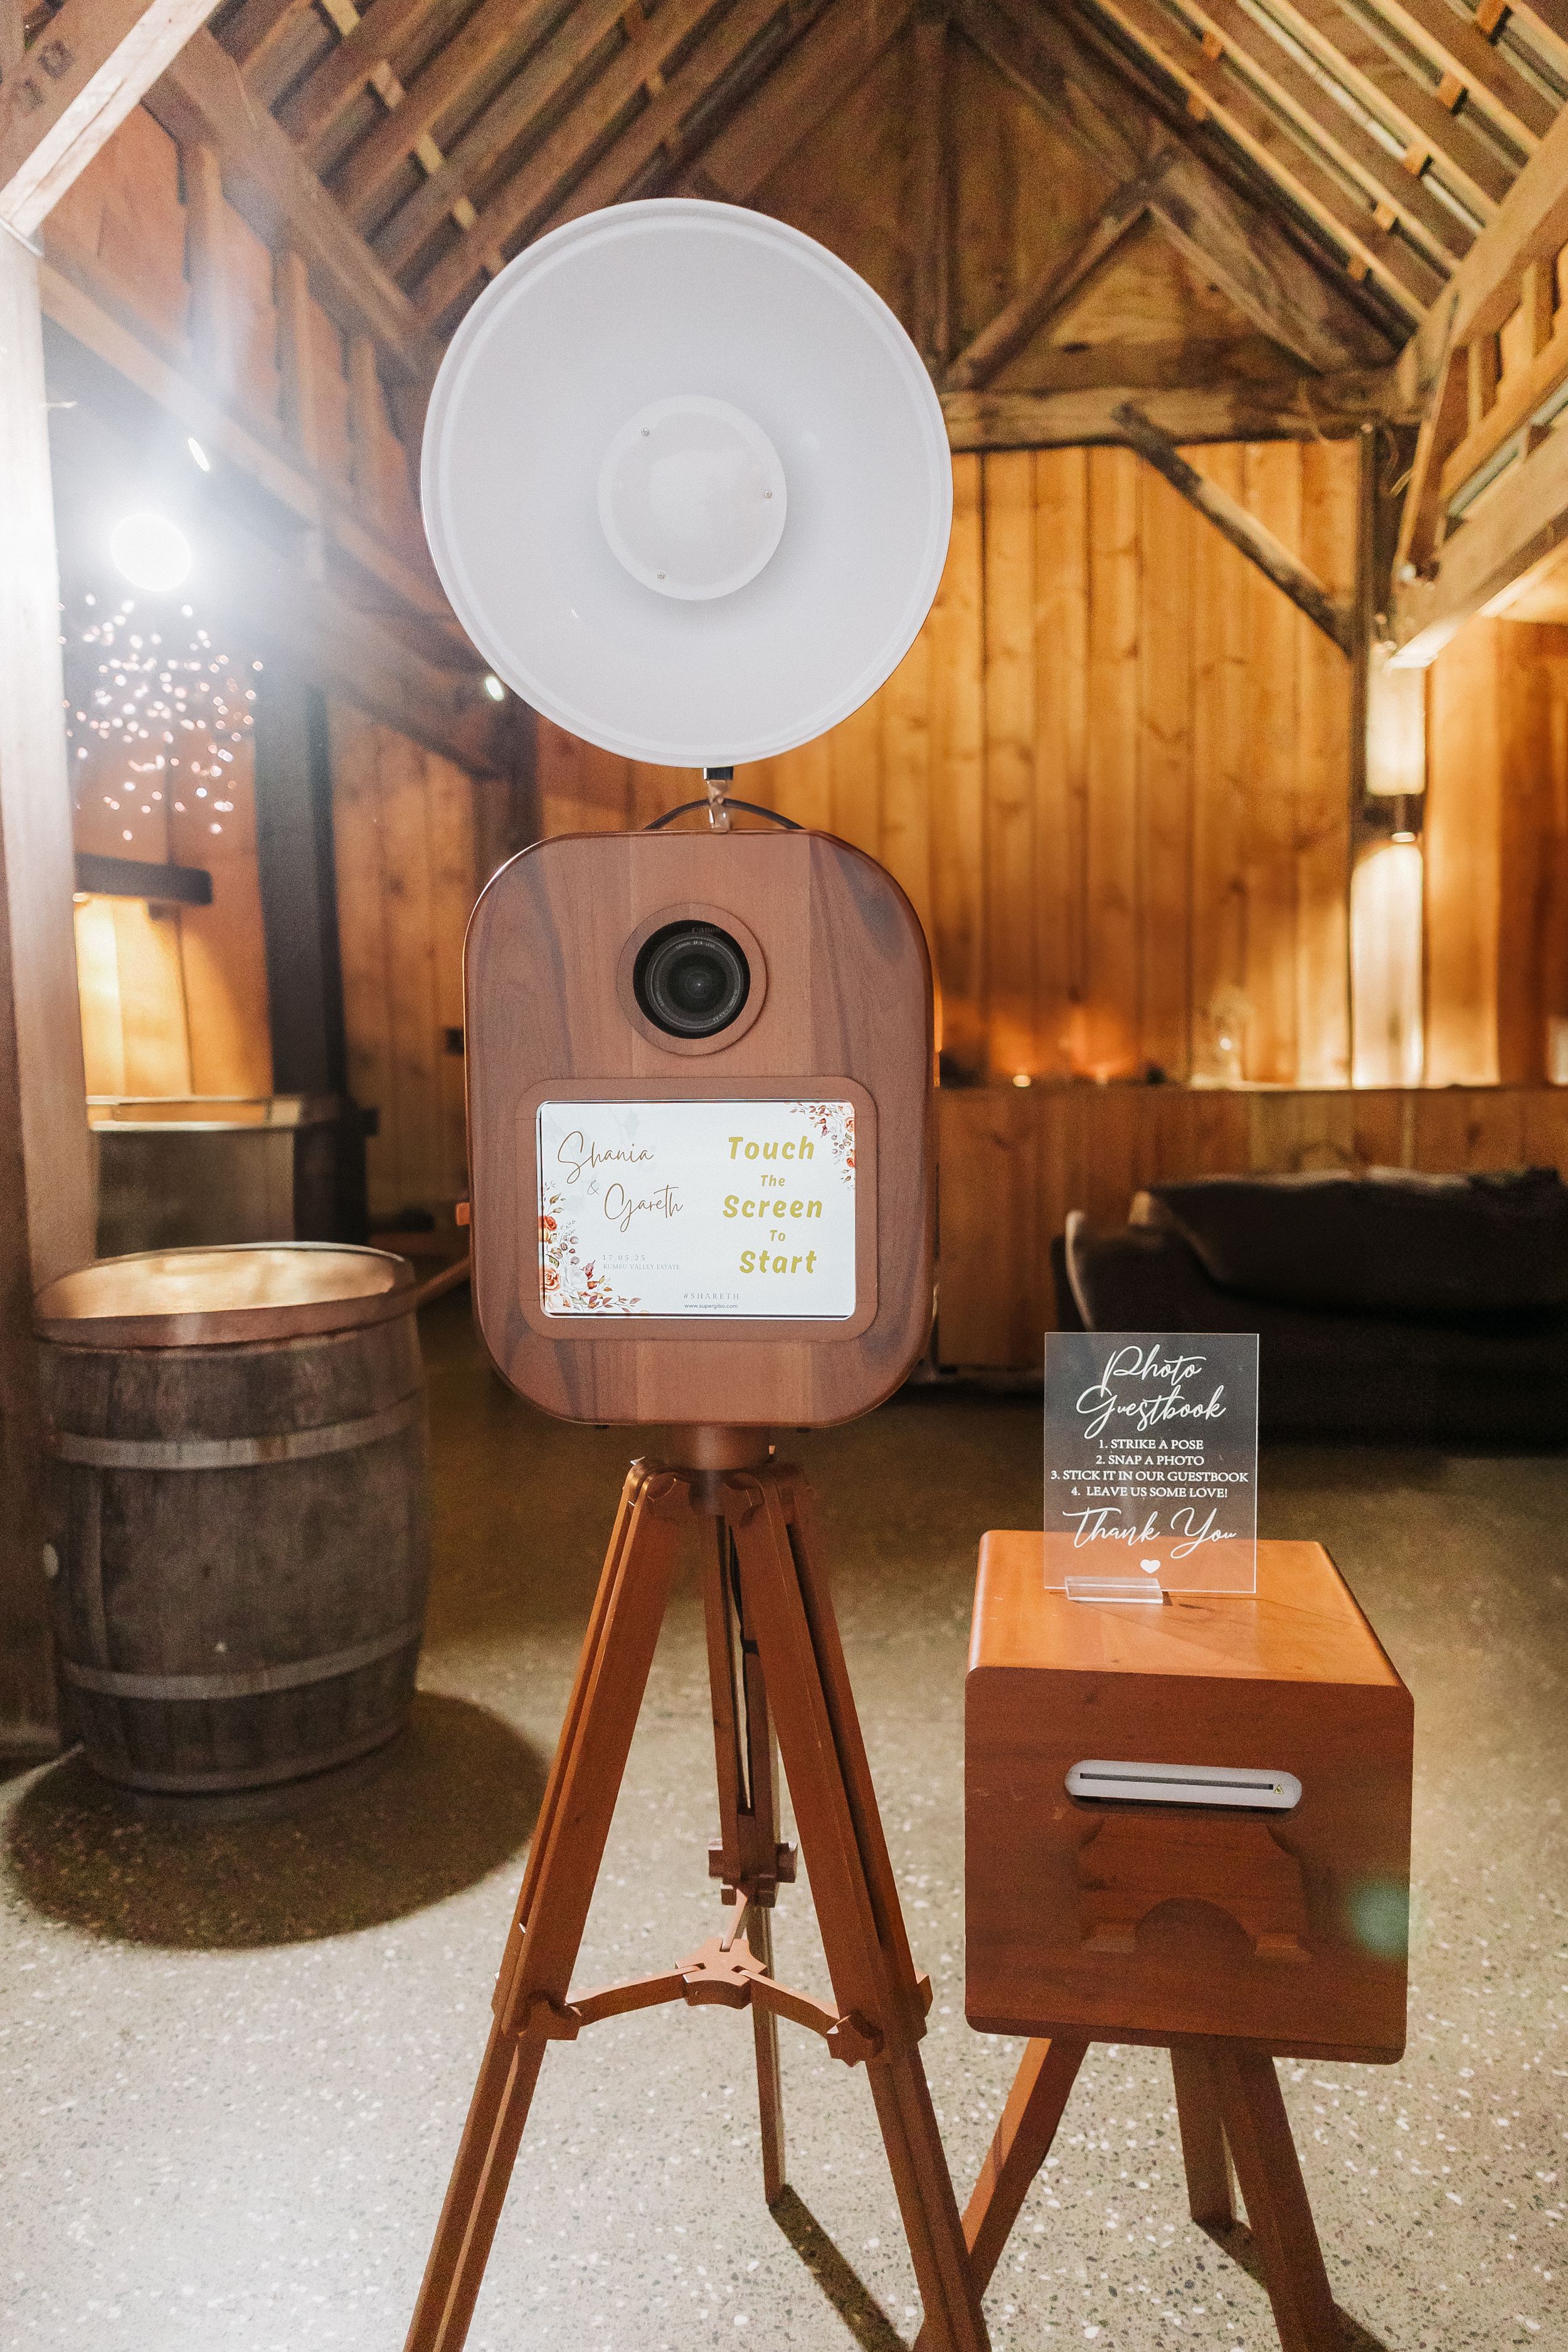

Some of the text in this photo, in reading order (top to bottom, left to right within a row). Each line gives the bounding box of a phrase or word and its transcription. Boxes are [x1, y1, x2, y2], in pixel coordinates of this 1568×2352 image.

[557, 1131, 654, 1184] Shania
[728, 1136, 815, 1160] Touch
[586, 1179, 600, 1195] &
[760, 1175, 786, 1187] The
[604, 1183, 684, 1232] Gareth
[723, 1194, 823, 1219] Screen
[770, 1229, 787, 1242] To
[739, 1250, 817, 1274] Start
[683, 1292, 739, 1300] #SHARETH
[1100, 1344, 1207, 1397] Photo
[1076, 1384, 1226, 1439] Guestbook
[1099, 1439, 1204, 1450] 1. STRIKE A POSE
[1096, 1455, 1205, 1466] 2. SNAP A PHOTO
[1051, 1470, 1249, 1483] 3. STICK IT IN OUR GUESTBOOK
[1071, 1486, 1228, 1498] 4. LEAVE US SOME LOVE!
[1062, 1507, 1237, 1559] Thank You
